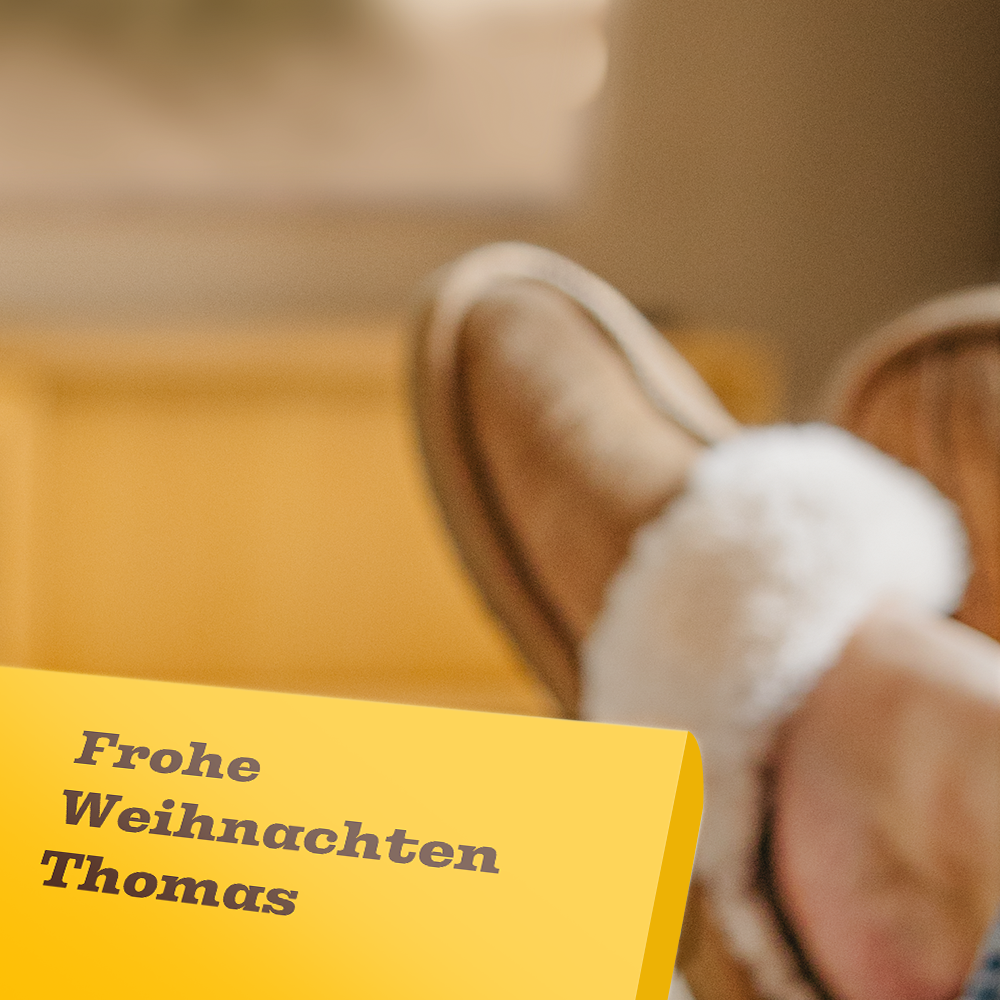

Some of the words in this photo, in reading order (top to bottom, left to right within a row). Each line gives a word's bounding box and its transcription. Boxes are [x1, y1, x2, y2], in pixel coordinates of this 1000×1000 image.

[74, 730, 261, 783] Frohe
[62, 789, 500, 874] Weihnachten
[40, 849, 299, 916] Thomas
